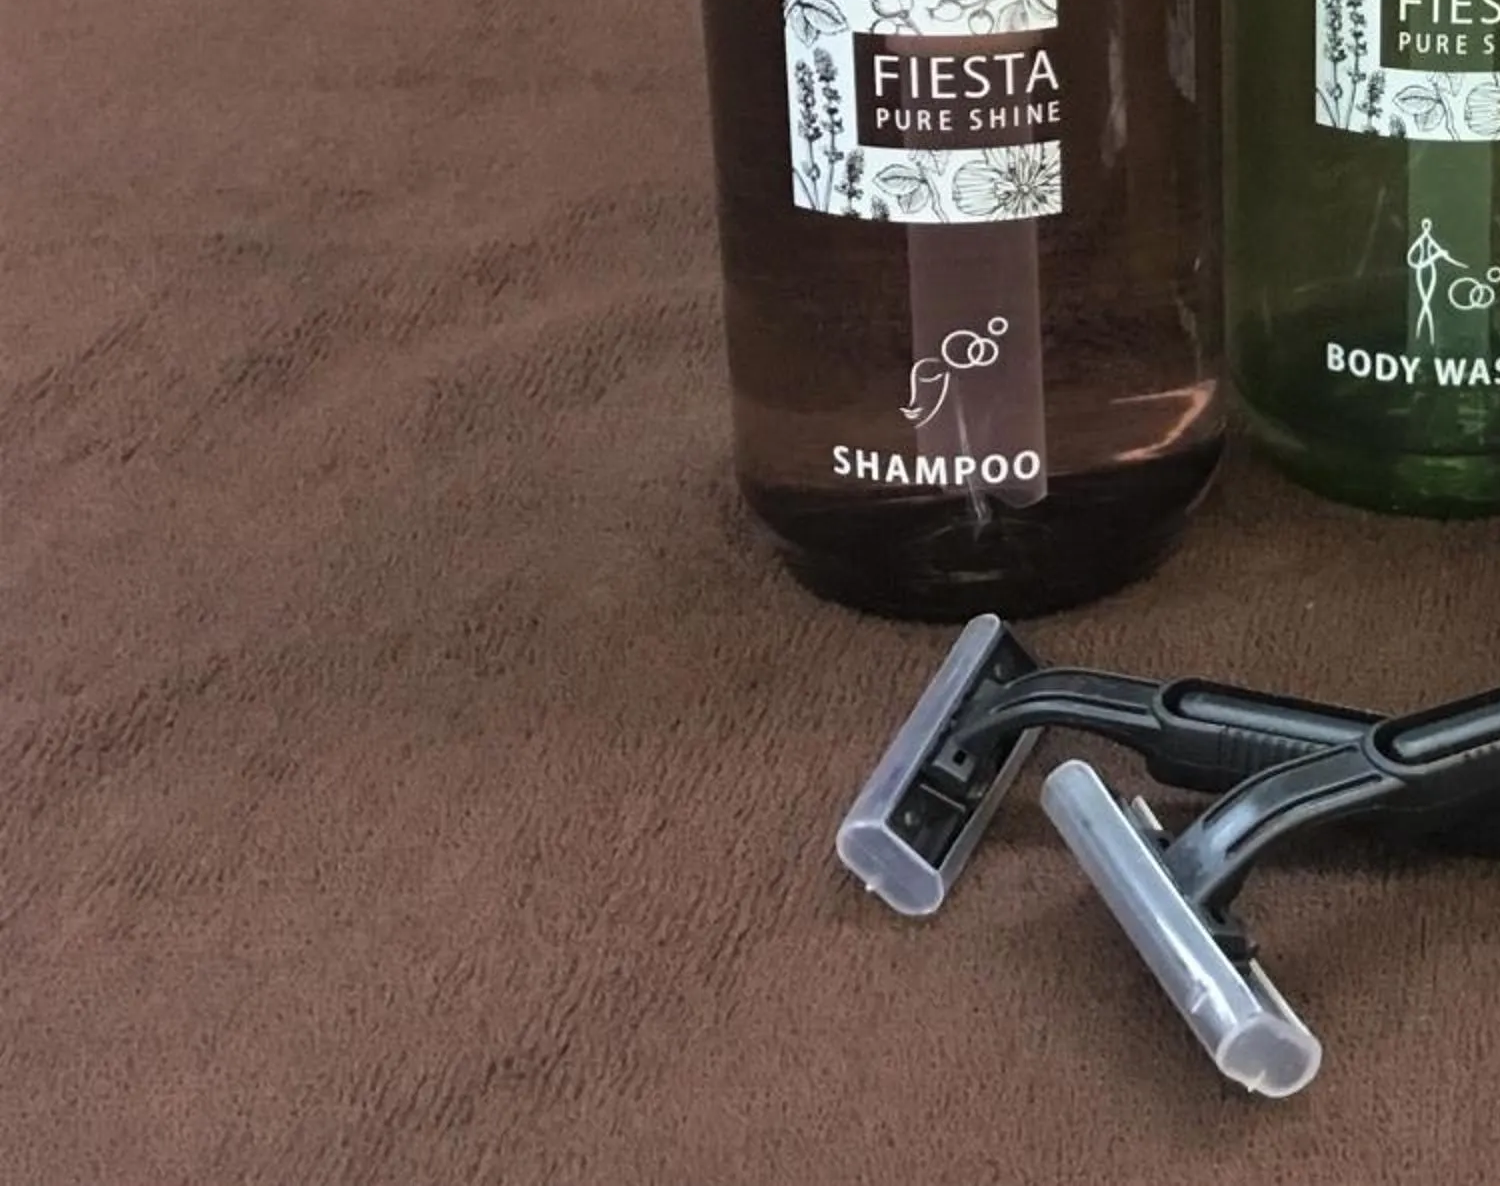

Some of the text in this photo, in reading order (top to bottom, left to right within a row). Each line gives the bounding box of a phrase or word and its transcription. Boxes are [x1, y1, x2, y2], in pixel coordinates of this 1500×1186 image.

[1399, 33, 1467, 55] PURE
[873, 49, 1060, 100] FIESTA
[876, 100, 1062, 131] PURE SHINE
[1326, 342, 1420, 384] BODY
[832, 445, 1041, 486] SHAMPOO
